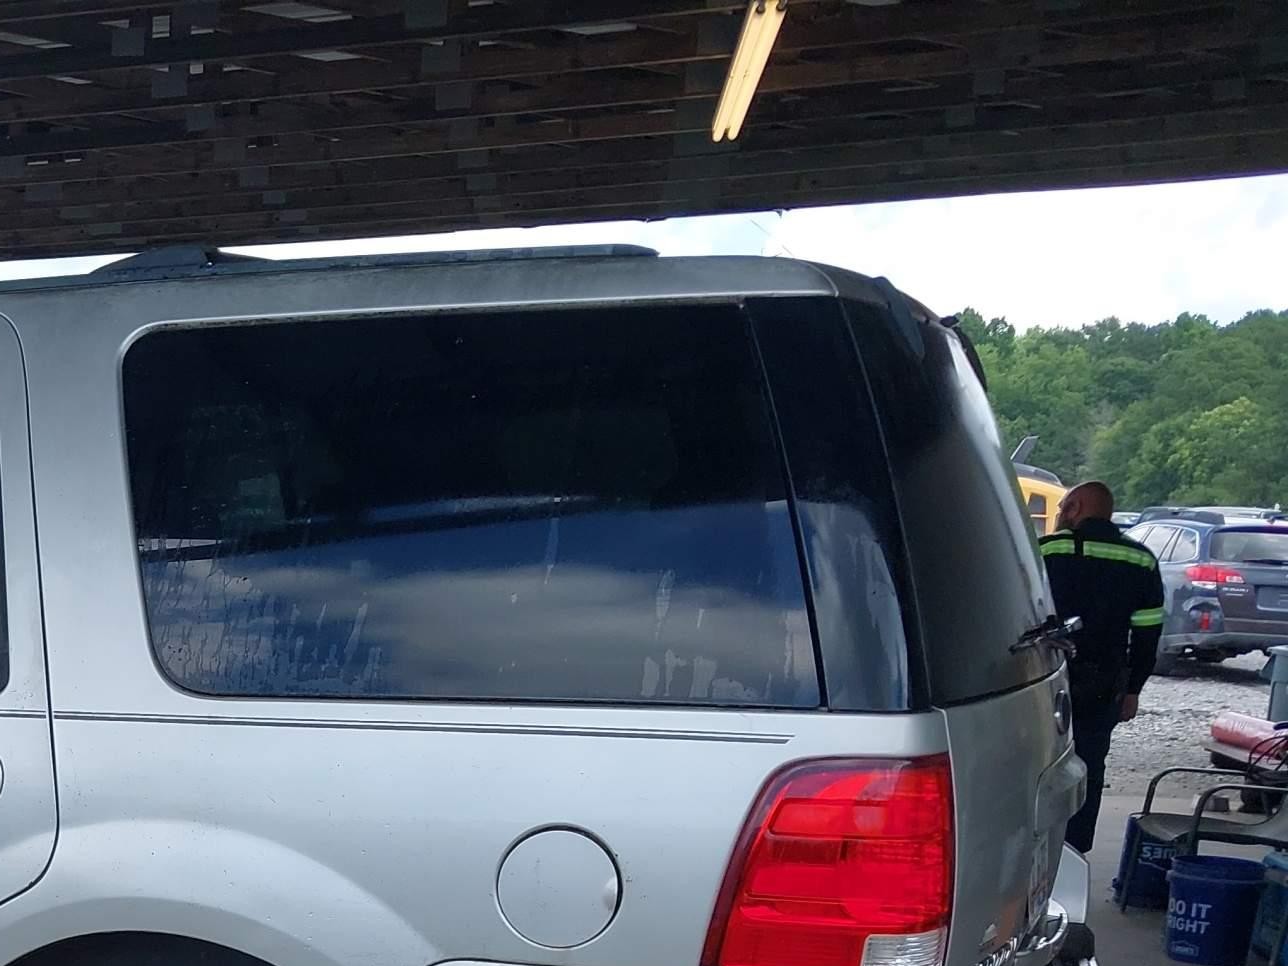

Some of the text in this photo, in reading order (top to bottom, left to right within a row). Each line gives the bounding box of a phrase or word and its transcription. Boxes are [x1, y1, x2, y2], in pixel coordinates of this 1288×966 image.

[1168, 897, 1212, 919] DO IT
[1167, 914, 1211, 934] RIGHT
